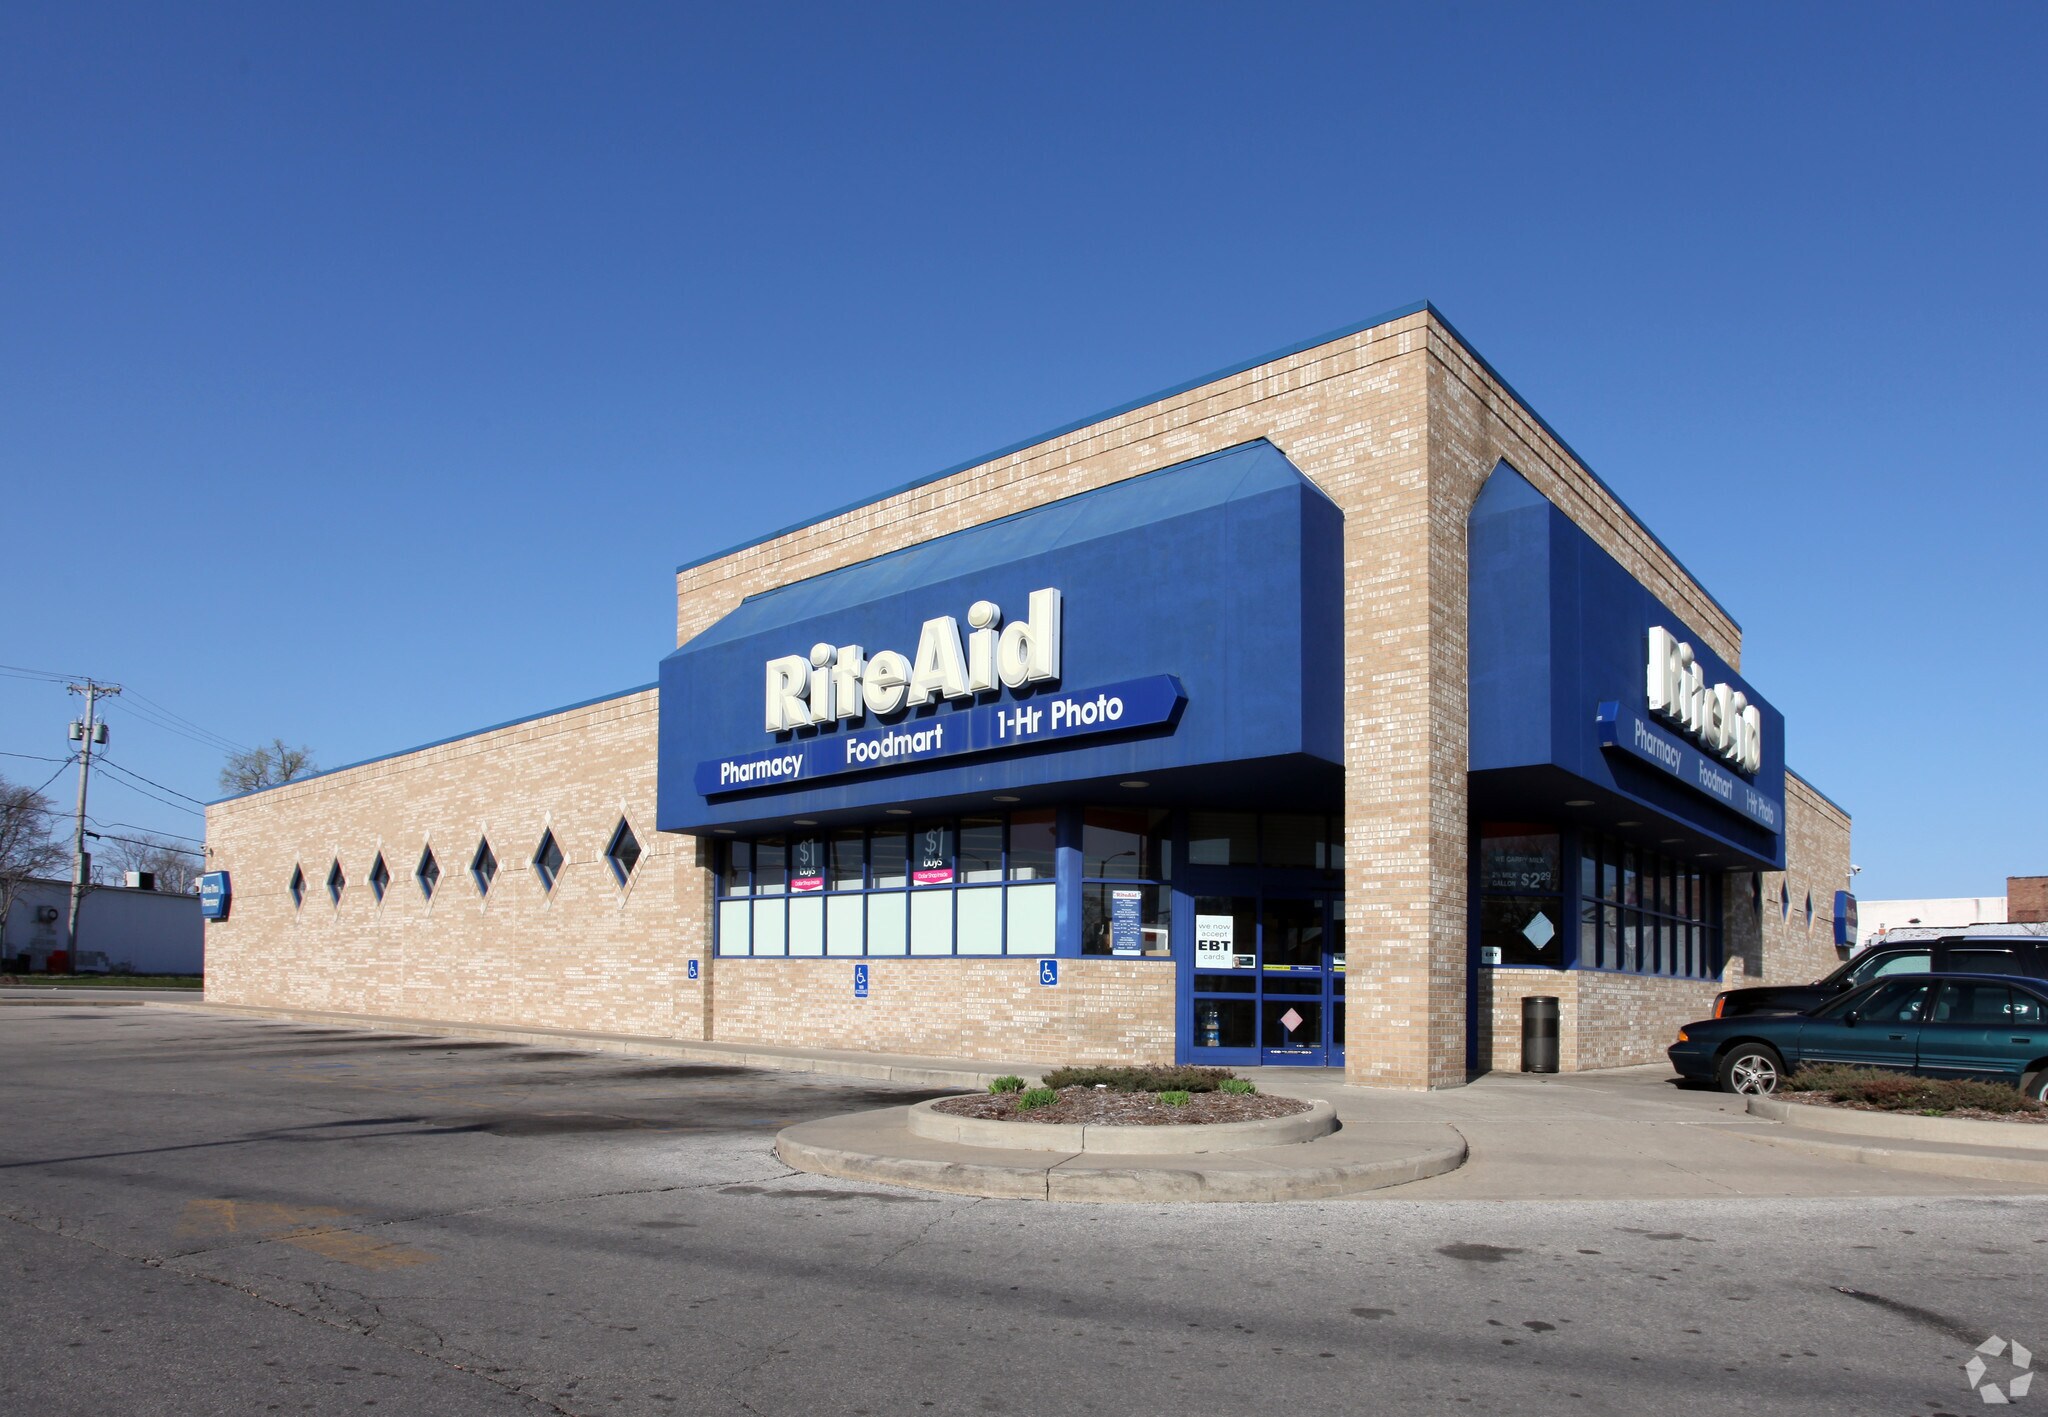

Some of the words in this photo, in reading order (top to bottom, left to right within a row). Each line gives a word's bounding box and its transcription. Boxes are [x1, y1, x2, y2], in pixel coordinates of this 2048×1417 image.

[721, 754, 803, 785] Pharmacy
[846, 723, 943, 764] Foodmart
[997, 705, 1042, 739] 1-Hr
[1051, 693, 1124, 730] Photo
[1635, 718, 1682, 775] Pharmacy
[1699, 759, 1733, 801] Foodmart
[1758, 798, 1774, 825] Photo
[925, 826, 944, 857] $1
[799, 838, 815, 866] $1
[799, 866, 816, 877] buys
[923, 856, 943, 869] buys
[1198, 940, 1231, 951] EBT
[1203, 953, 1225, 961] cards
